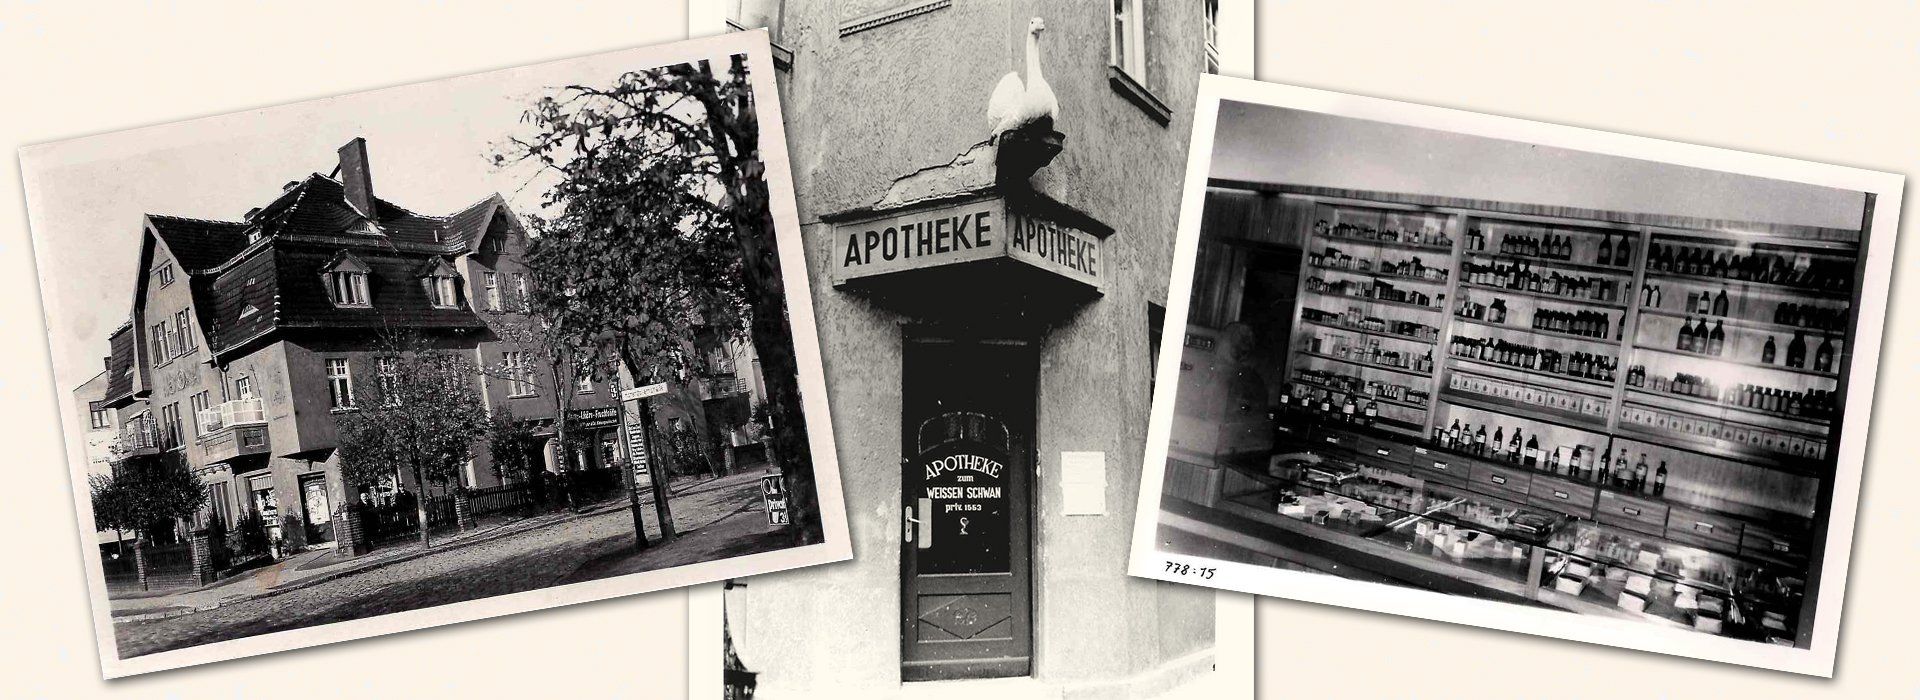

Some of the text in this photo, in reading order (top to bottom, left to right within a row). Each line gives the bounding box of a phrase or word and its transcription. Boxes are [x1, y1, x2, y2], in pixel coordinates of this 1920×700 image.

[843, 211, 991, 268] APOTHEKE
[1012, 214, 1097, 277] APOTHEKE
[925, 454, 1003, 480] APOTHEKE
[926, 486, 1001, 499] WEISSEN SCHWAN
